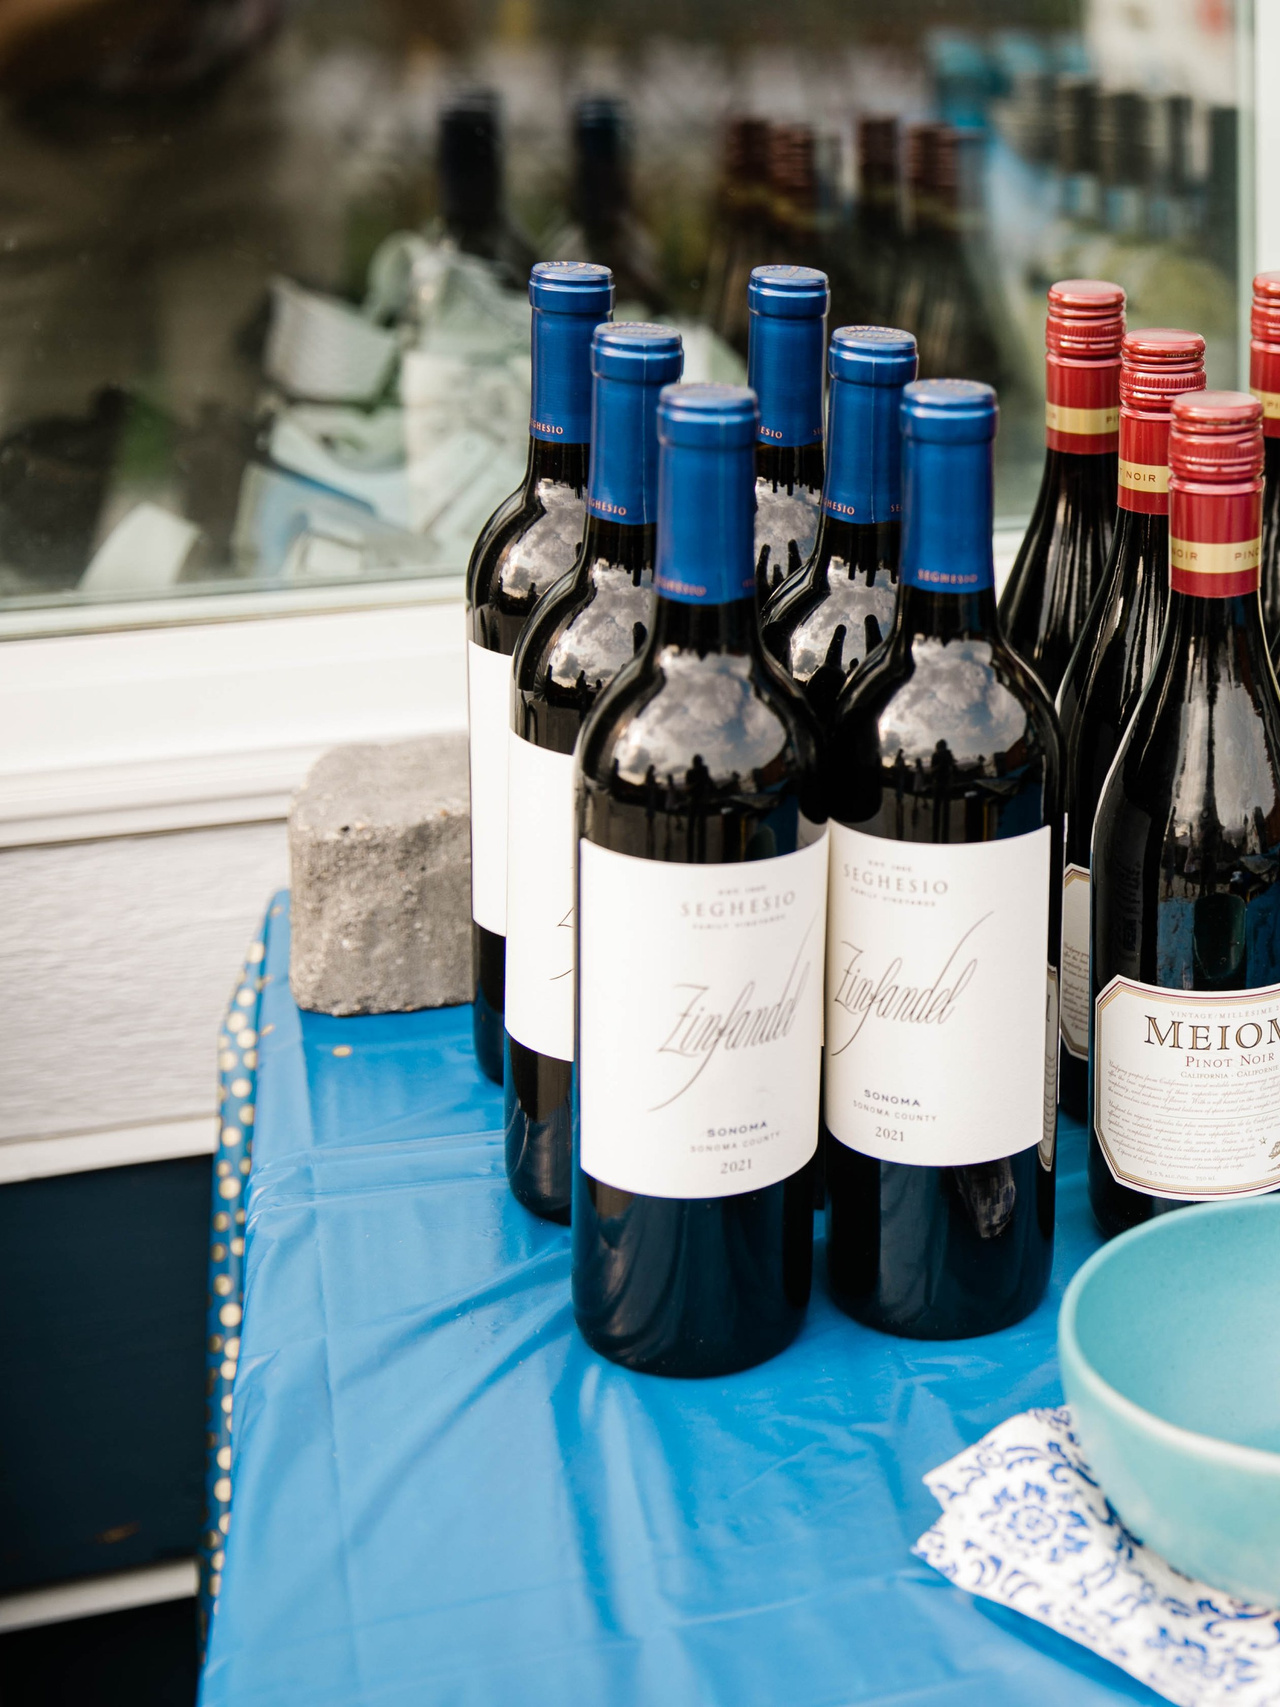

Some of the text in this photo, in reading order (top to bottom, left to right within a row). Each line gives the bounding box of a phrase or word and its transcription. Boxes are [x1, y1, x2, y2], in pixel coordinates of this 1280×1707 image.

[1125, 472, 1157, 483] NOIR
[1234, 547, 1260, 561] PINO
[843, 863, 949, 895] SEGHESIO
[680, 889, 796, 918] SEGHESIO
[831, 910, 994, 1056] Zinfandel
[648, 905, 820, 1112] Zinfandel
[1185, 1052, 1275, 1069] PINOT NOIR
[1180, 1064, 1280, 1079] CALIFORNIA CALIFORNIE
[863, 1089, 921, 1108] SONOMA
[853, 1099, 937, 1122] SONOMA COUNTY
[707, 1120, 768, 1138] SONOMA
[875, 1126, 905, 1142] 2021
[690, 1130, 780, 1153] SONOMA COUNTY
[720, 1158, 752, 1174] 2021
